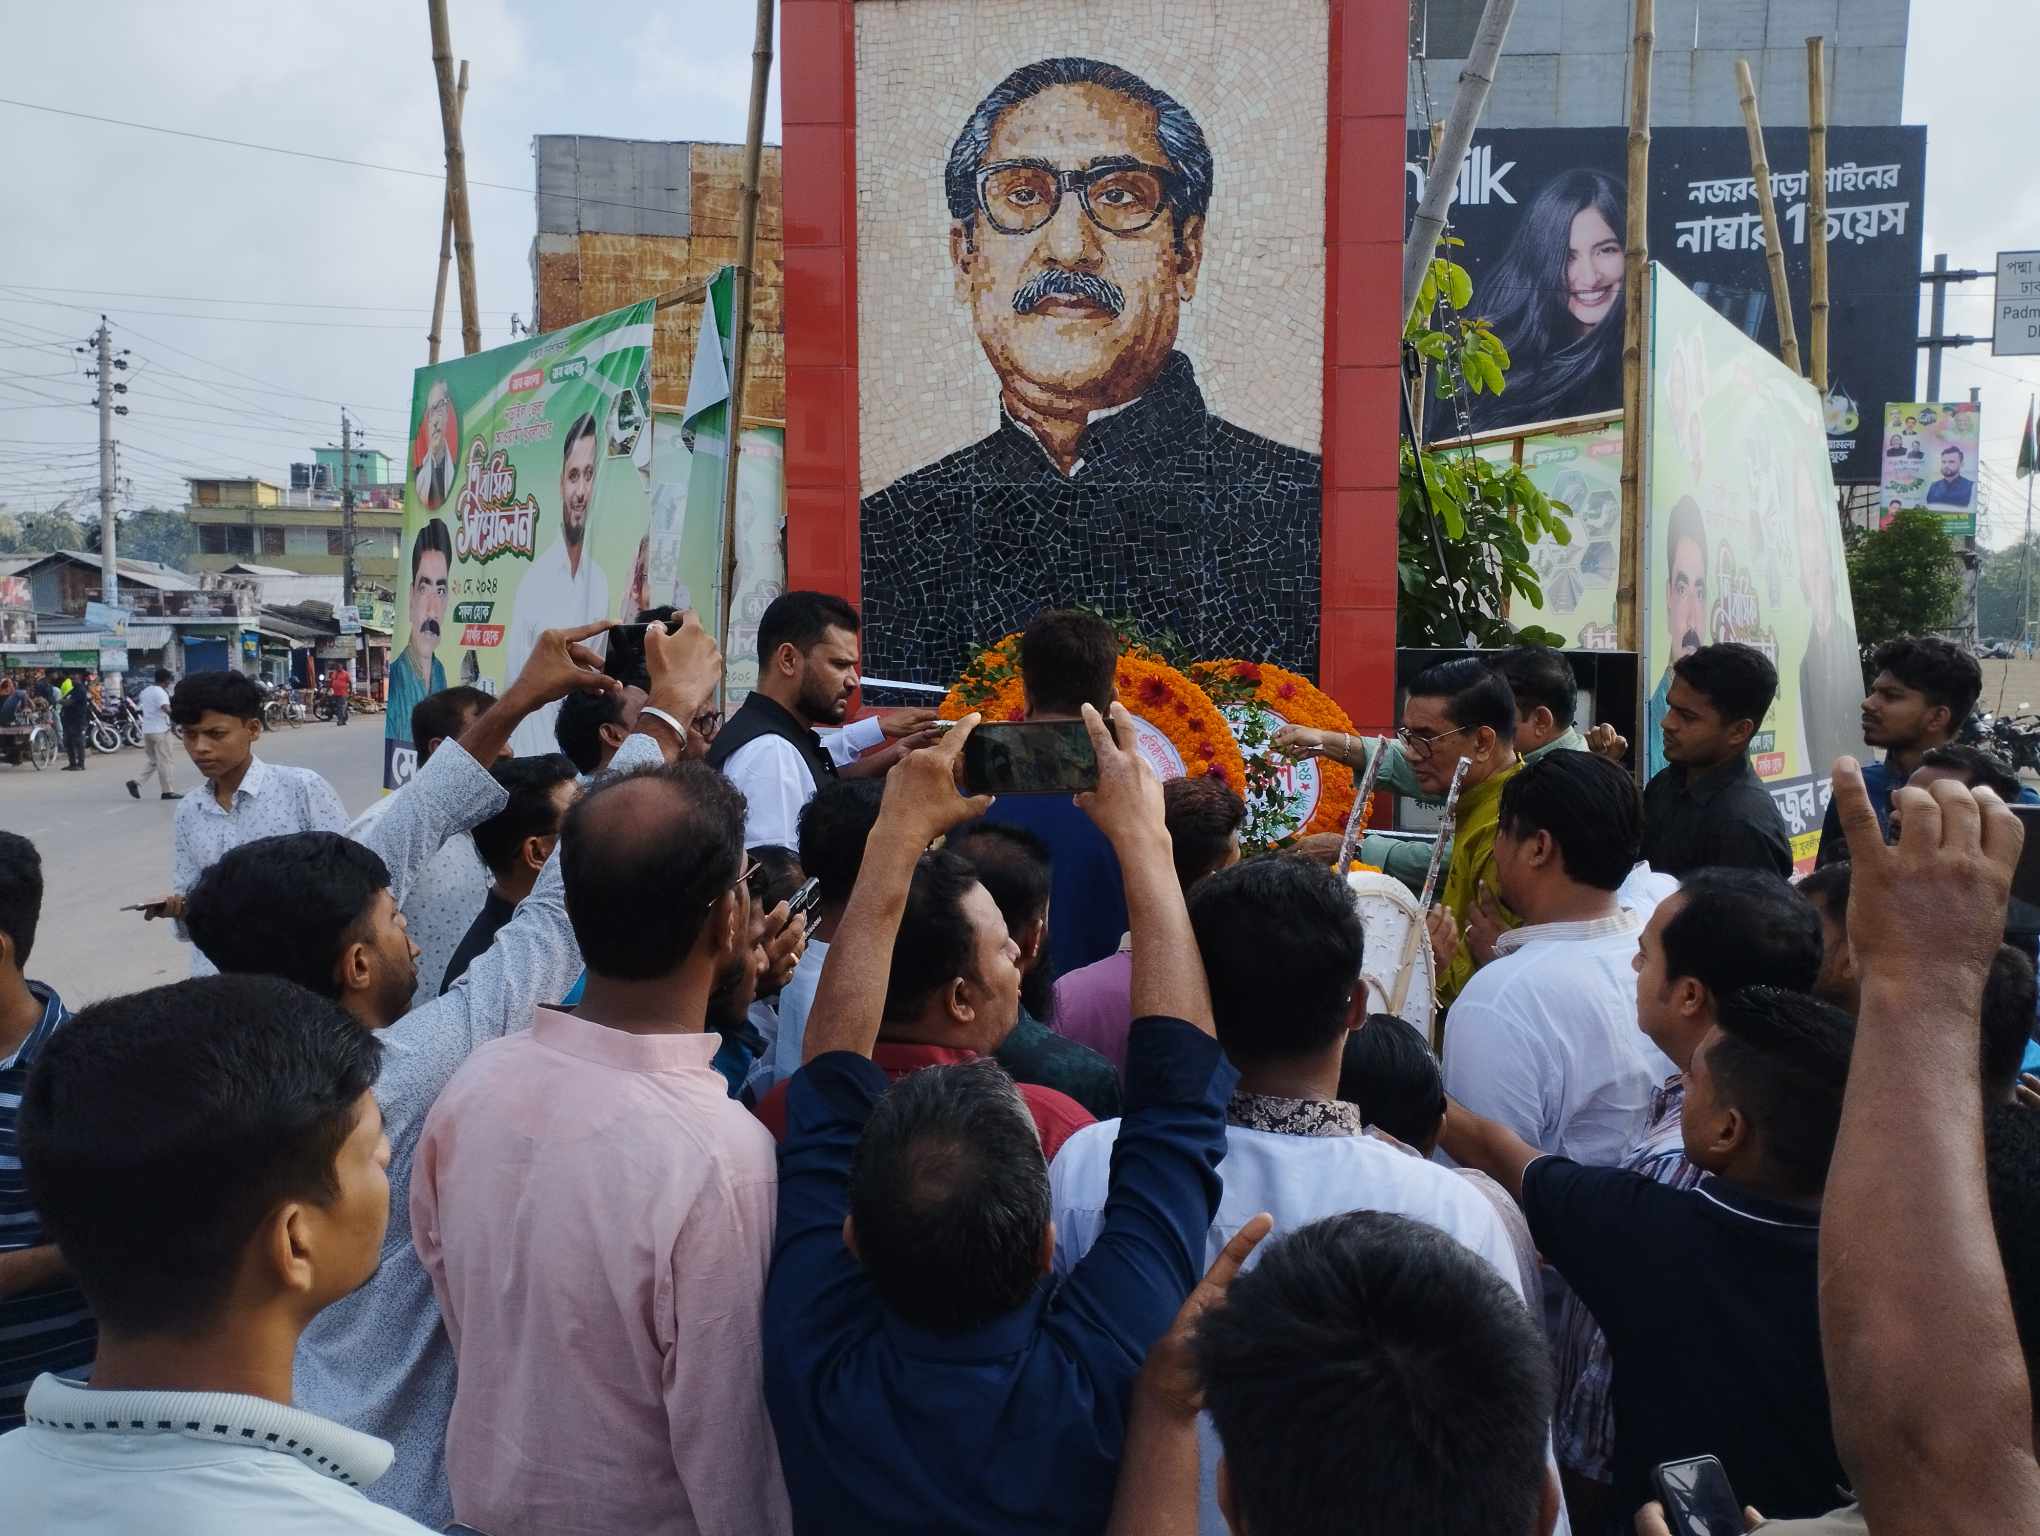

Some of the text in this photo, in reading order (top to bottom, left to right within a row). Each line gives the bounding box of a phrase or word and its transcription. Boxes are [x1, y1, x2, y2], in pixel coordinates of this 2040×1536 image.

[1785, 202, 1807, 245] 1
[2006, 260, 2032, 274] পদ্মা
[476, 578, 498, 595] ২০২৪
